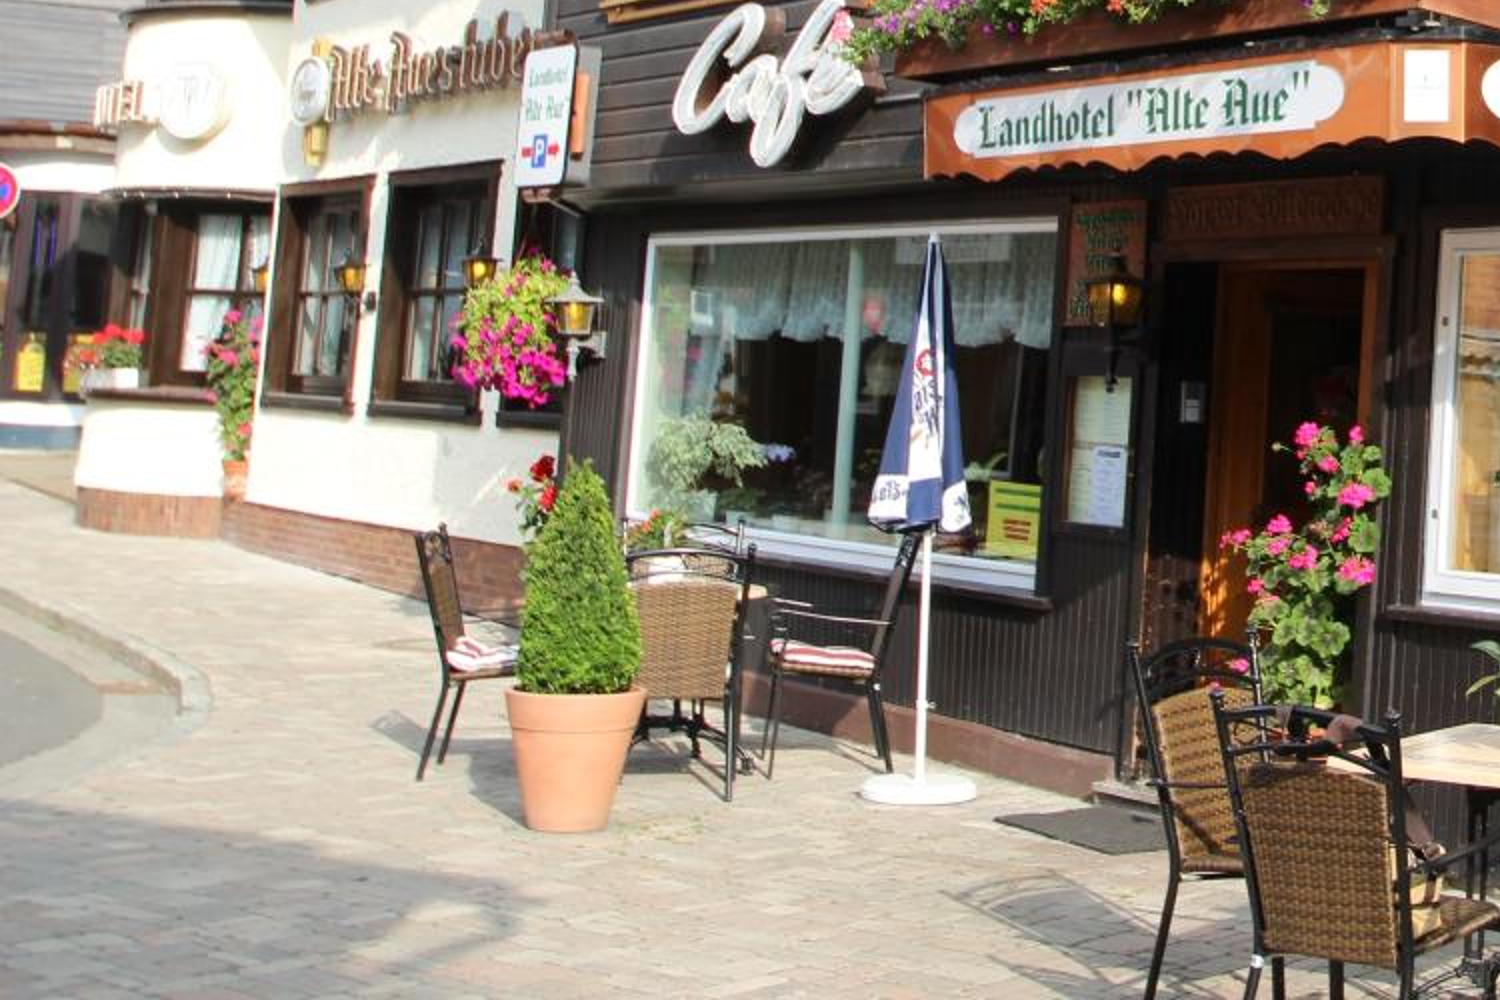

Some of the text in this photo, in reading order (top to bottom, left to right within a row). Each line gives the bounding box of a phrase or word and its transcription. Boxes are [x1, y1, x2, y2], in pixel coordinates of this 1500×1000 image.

[978, 69, 1311, 150] Landhotel "Alte Aue"
